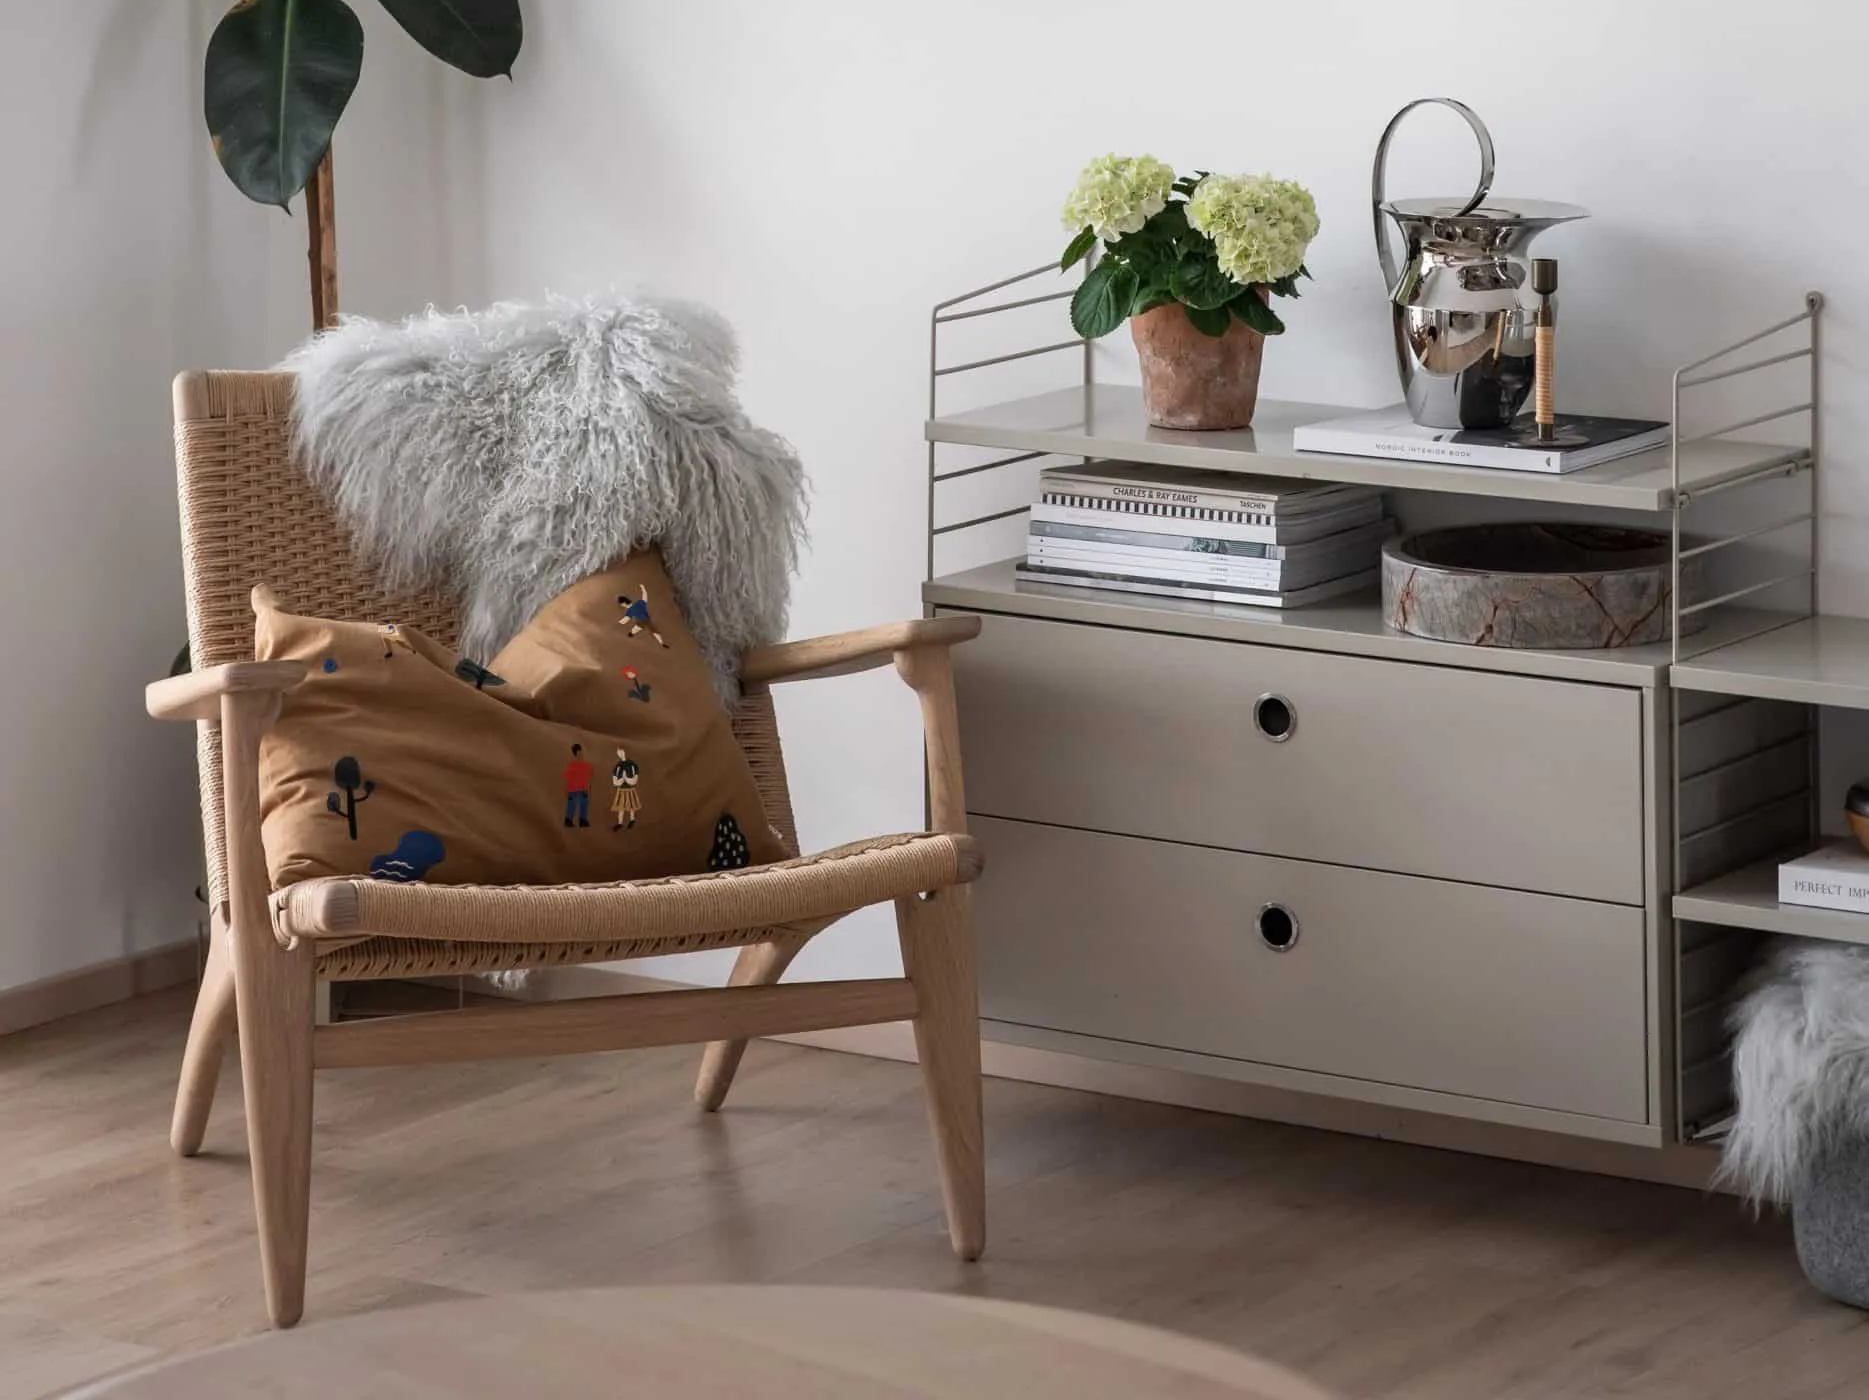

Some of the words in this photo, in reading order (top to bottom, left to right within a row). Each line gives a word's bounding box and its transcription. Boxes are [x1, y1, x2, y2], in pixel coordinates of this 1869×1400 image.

[1112, 486, 1146, 499] CHARLES
[1156, 491, 1171, 501] RAY
[1172, 493, 1199, 504] EAMES
[1239, 500, 1267, 510] TASCHEN
[1794, 880, 1842, 896] PERFECT
